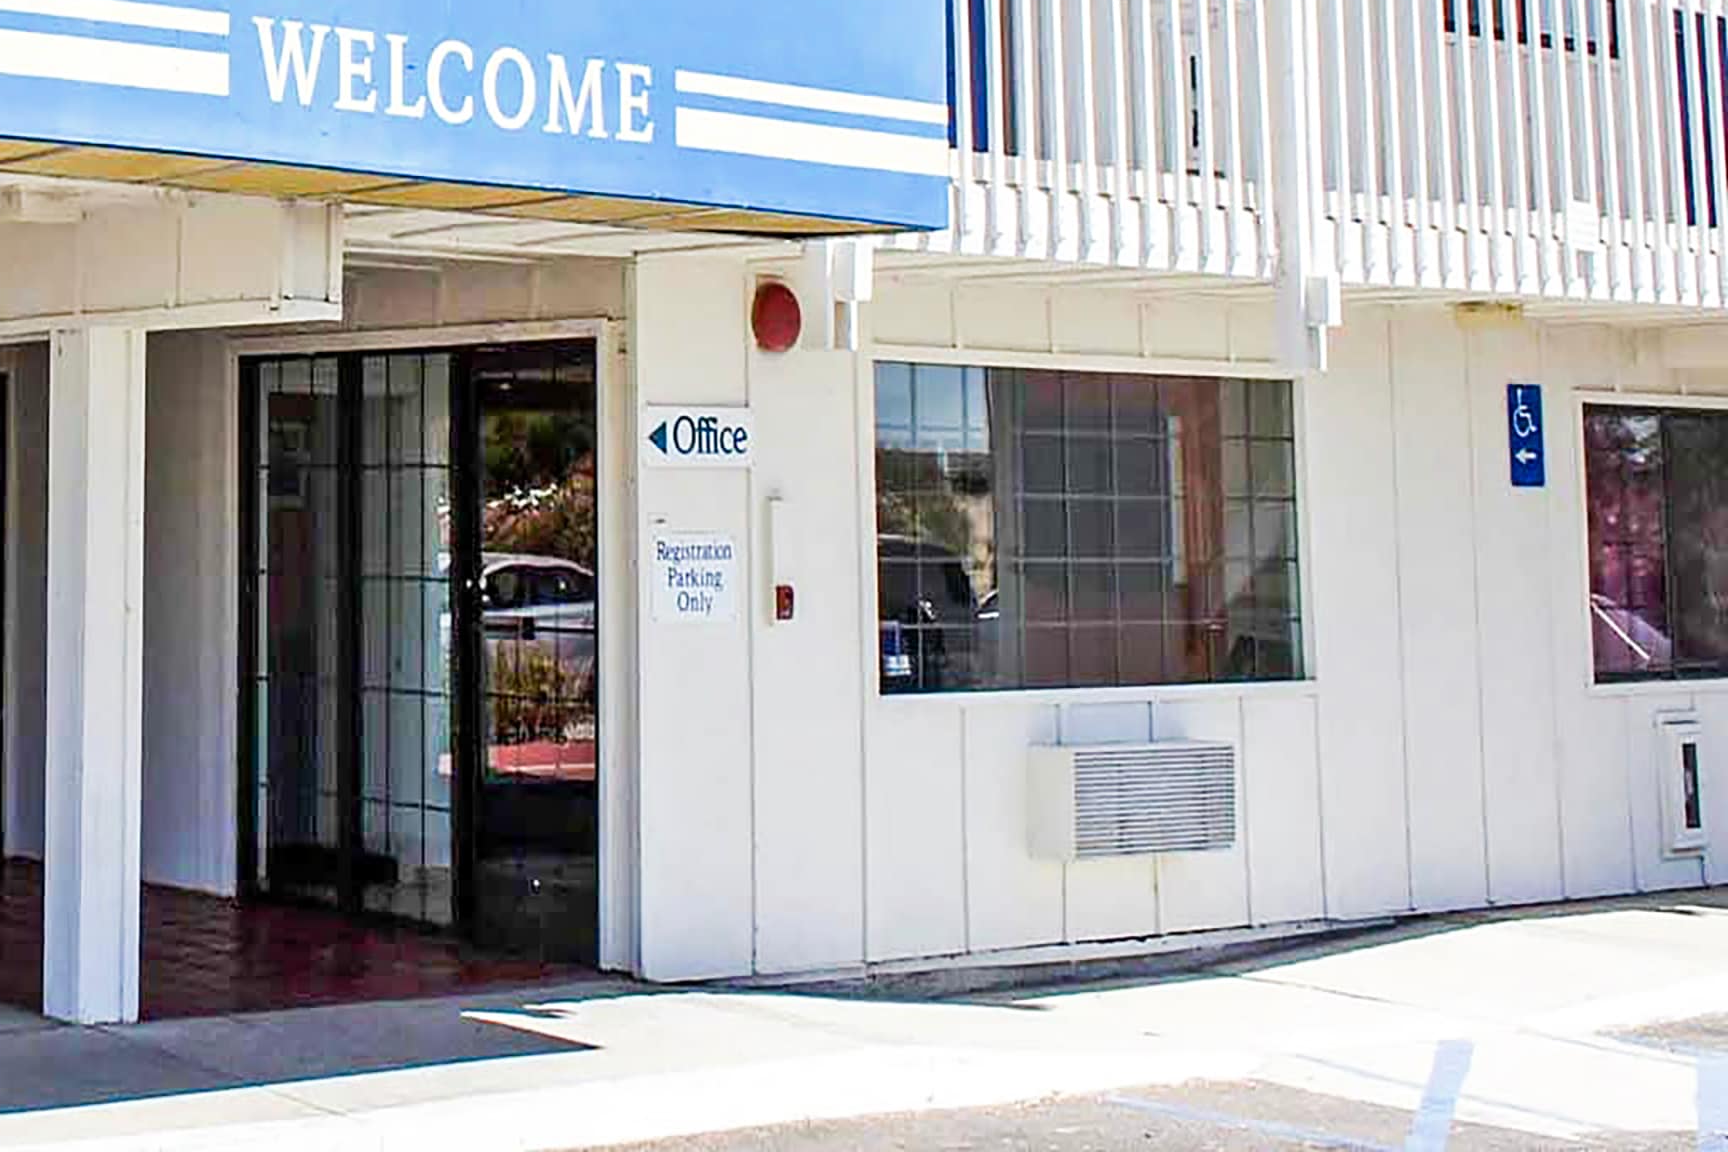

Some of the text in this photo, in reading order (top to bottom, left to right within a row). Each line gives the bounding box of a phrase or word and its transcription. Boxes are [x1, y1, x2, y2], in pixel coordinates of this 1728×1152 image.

[251, 15, 656, 144] WELCOME
[672, 415, 748, 454] Office
[656, 541, 732, 564] Registration
[667, 567, 723, 591] Parking
[677, 591, 713, 615] Only
